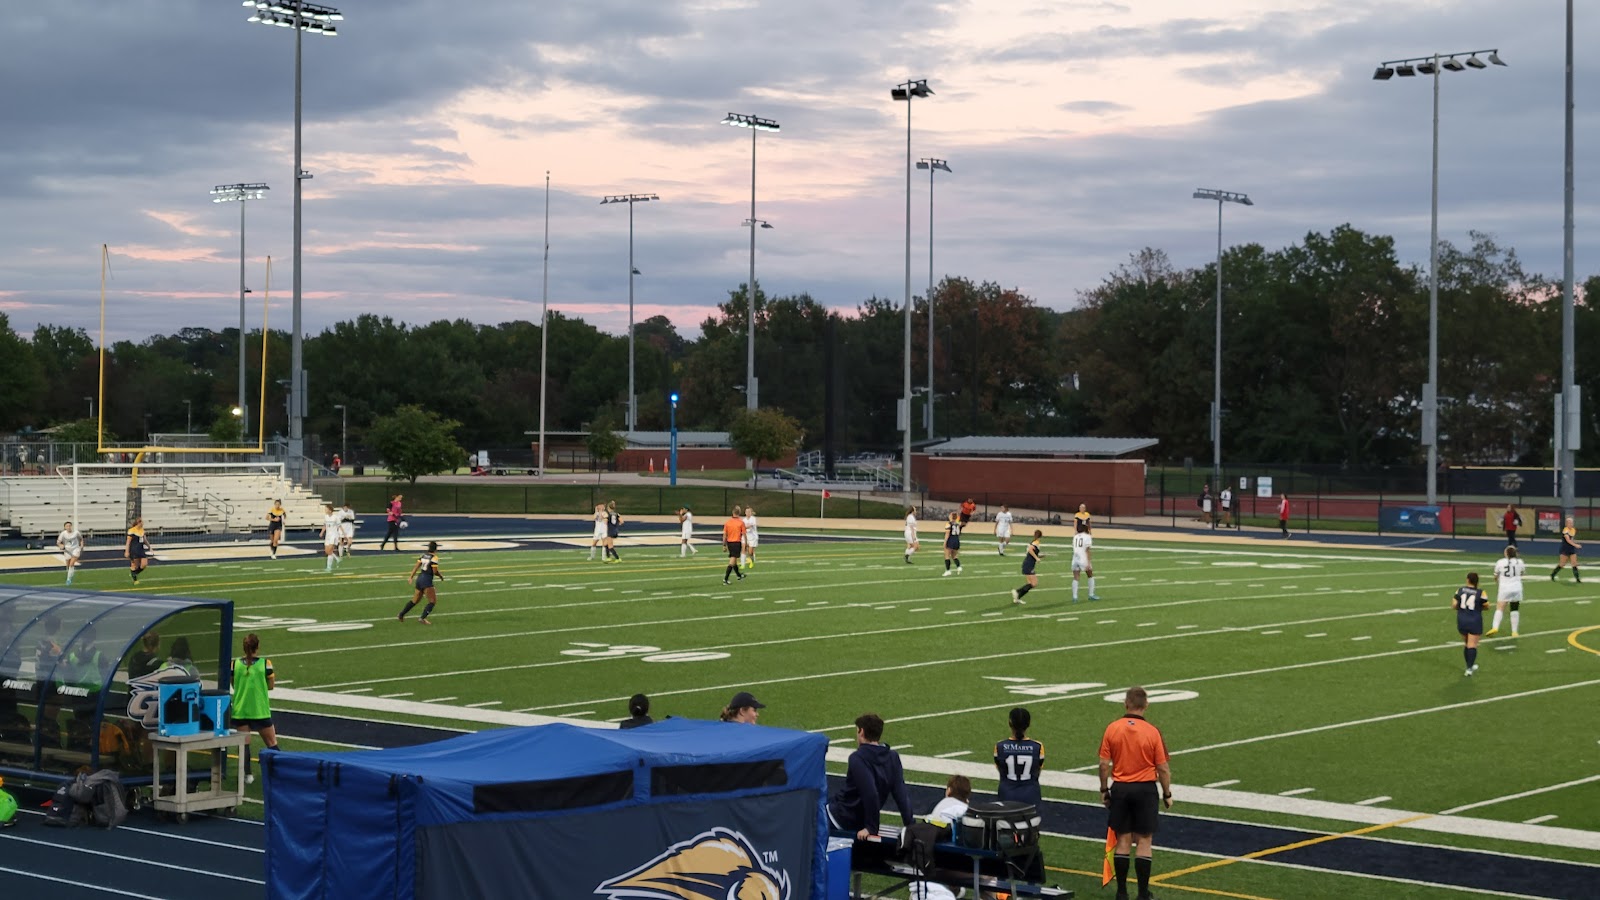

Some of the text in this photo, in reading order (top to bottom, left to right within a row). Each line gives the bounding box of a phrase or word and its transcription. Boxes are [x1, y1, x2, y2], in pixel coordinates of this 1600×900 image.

[1075, 537, 1084, 548] 10
[1503, 565, 1516, 577] 21
[1460, 593, 1476, 610] 14
[1005, 755, 1033, 781] 17
[762, 850, 778, 863] TM
